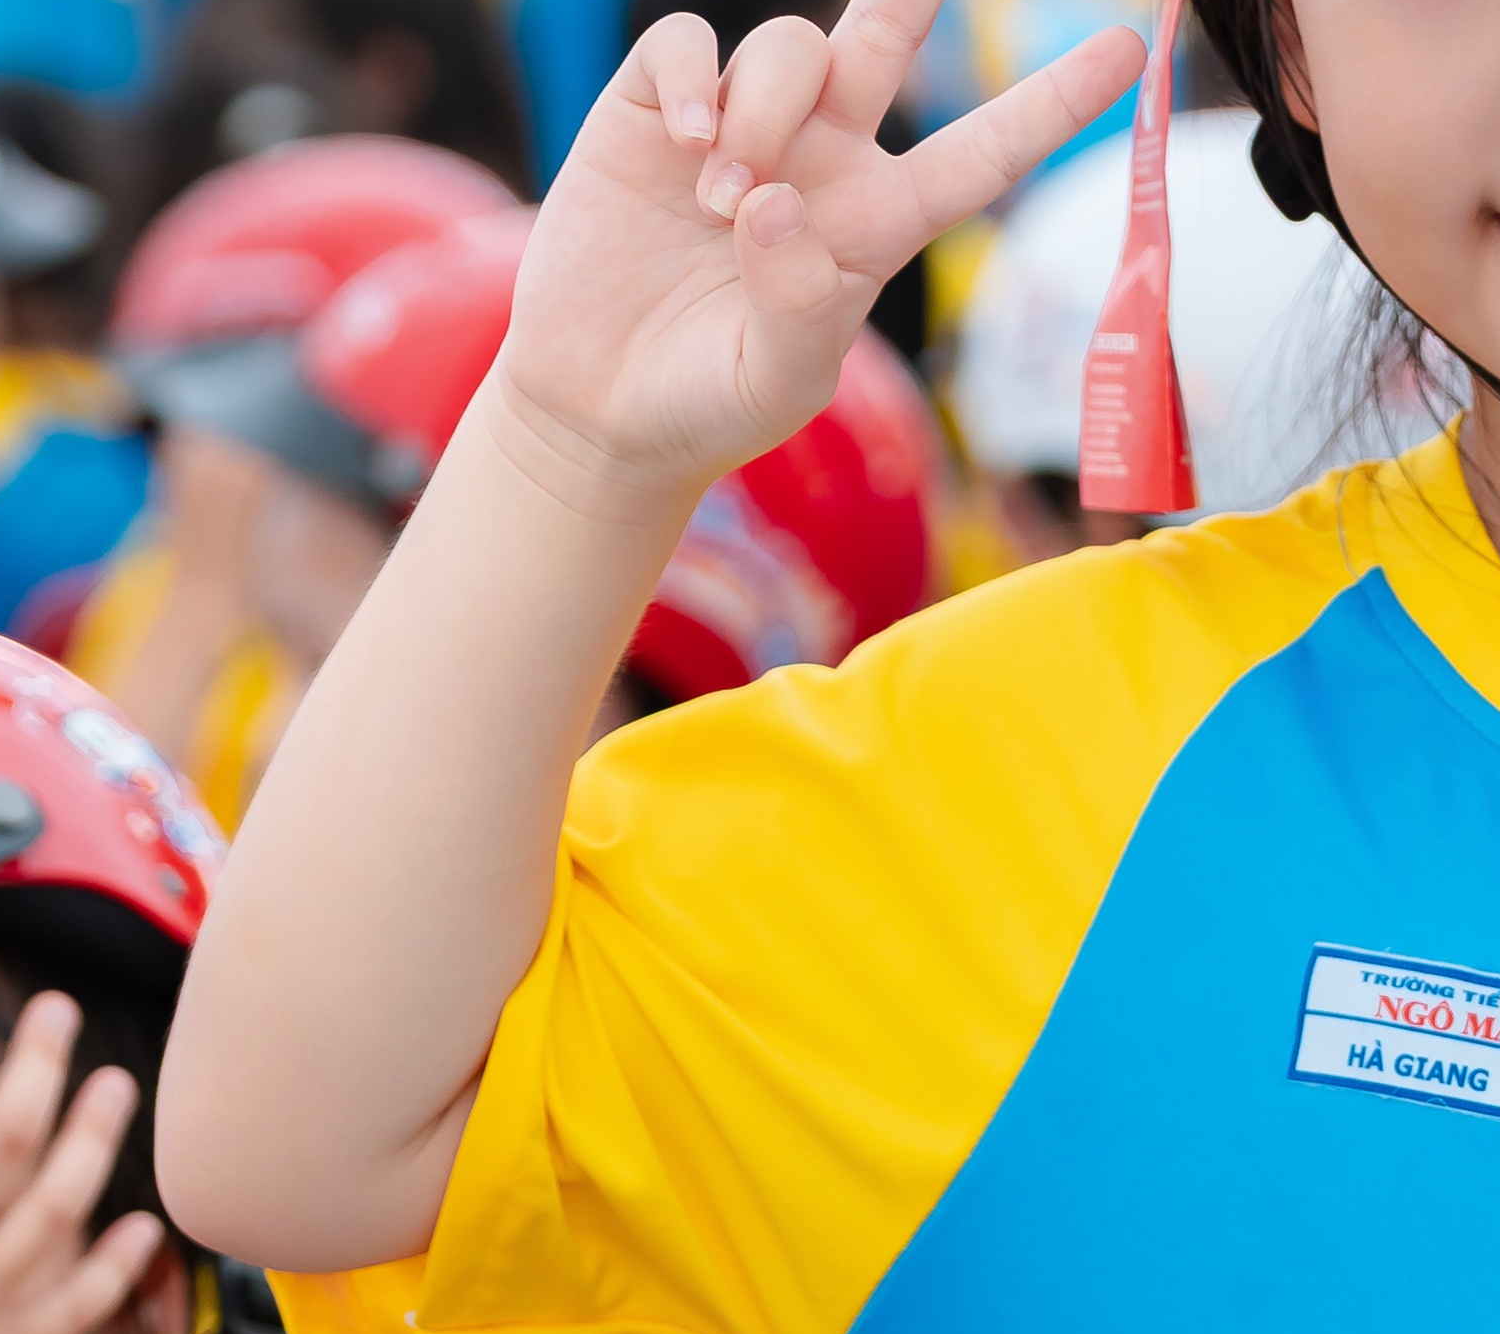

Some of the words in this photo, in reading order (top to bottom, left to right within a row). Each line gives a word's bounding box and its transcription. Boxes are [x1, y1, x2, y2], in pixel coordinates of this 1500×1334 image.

[1359, 969, 1455, 999] TRƯỜNG
[1374, 994, 1456, 1033] NGÔ
[1346, 1039, 1385, 1073] HÀ
[1393, 1052, 1490, 1093] GIANG
